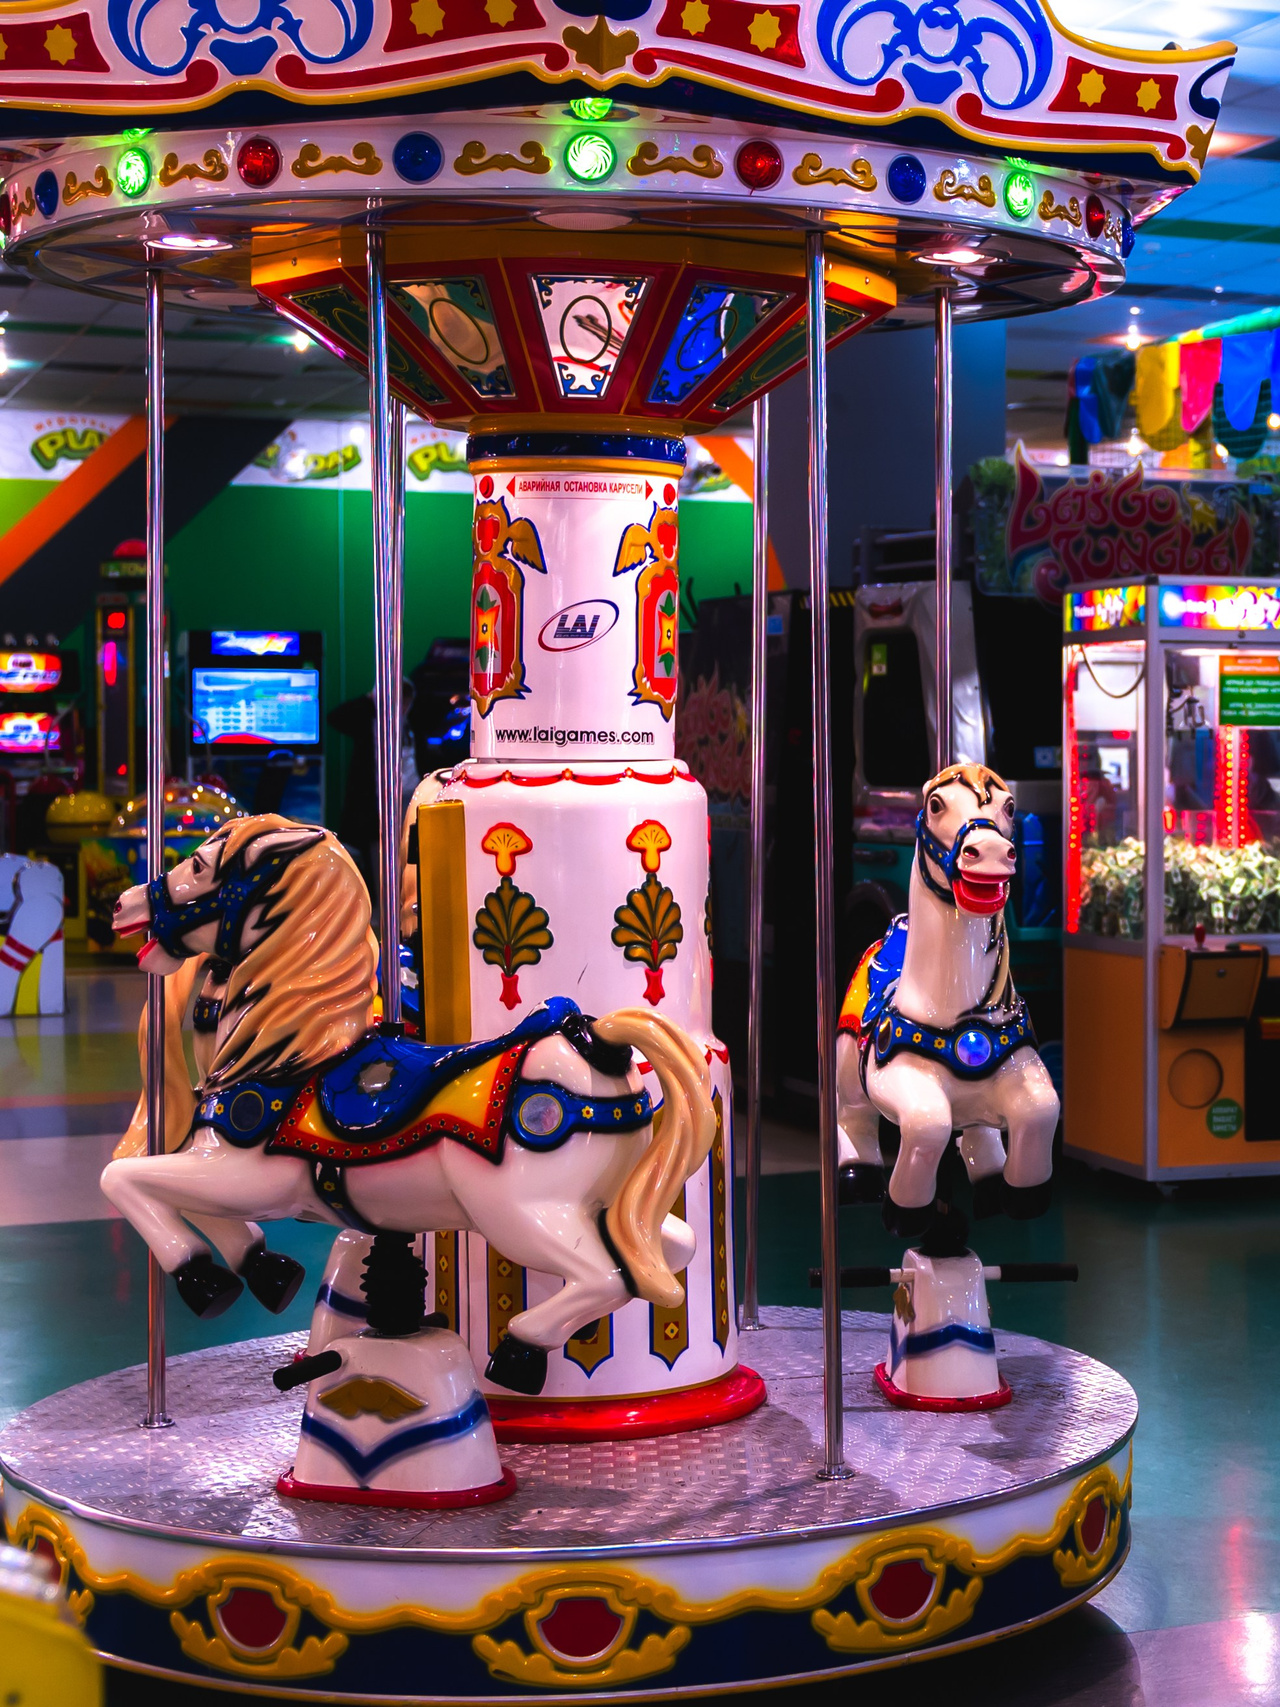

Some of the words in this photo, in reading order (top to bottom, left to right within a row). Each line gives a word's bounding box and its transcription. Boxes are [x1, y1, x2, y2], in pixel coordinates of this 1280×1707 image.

[518, 478, 561, 492] АВАРИЙНАЯ
[563, 480, 608, 493] ОСТАНОВКА
[609, 482, 643, 495] КАРУСЕЛИ
[553, 614, 601, 634] LAI
[495, 726, 655, 747] www.laigames.com
